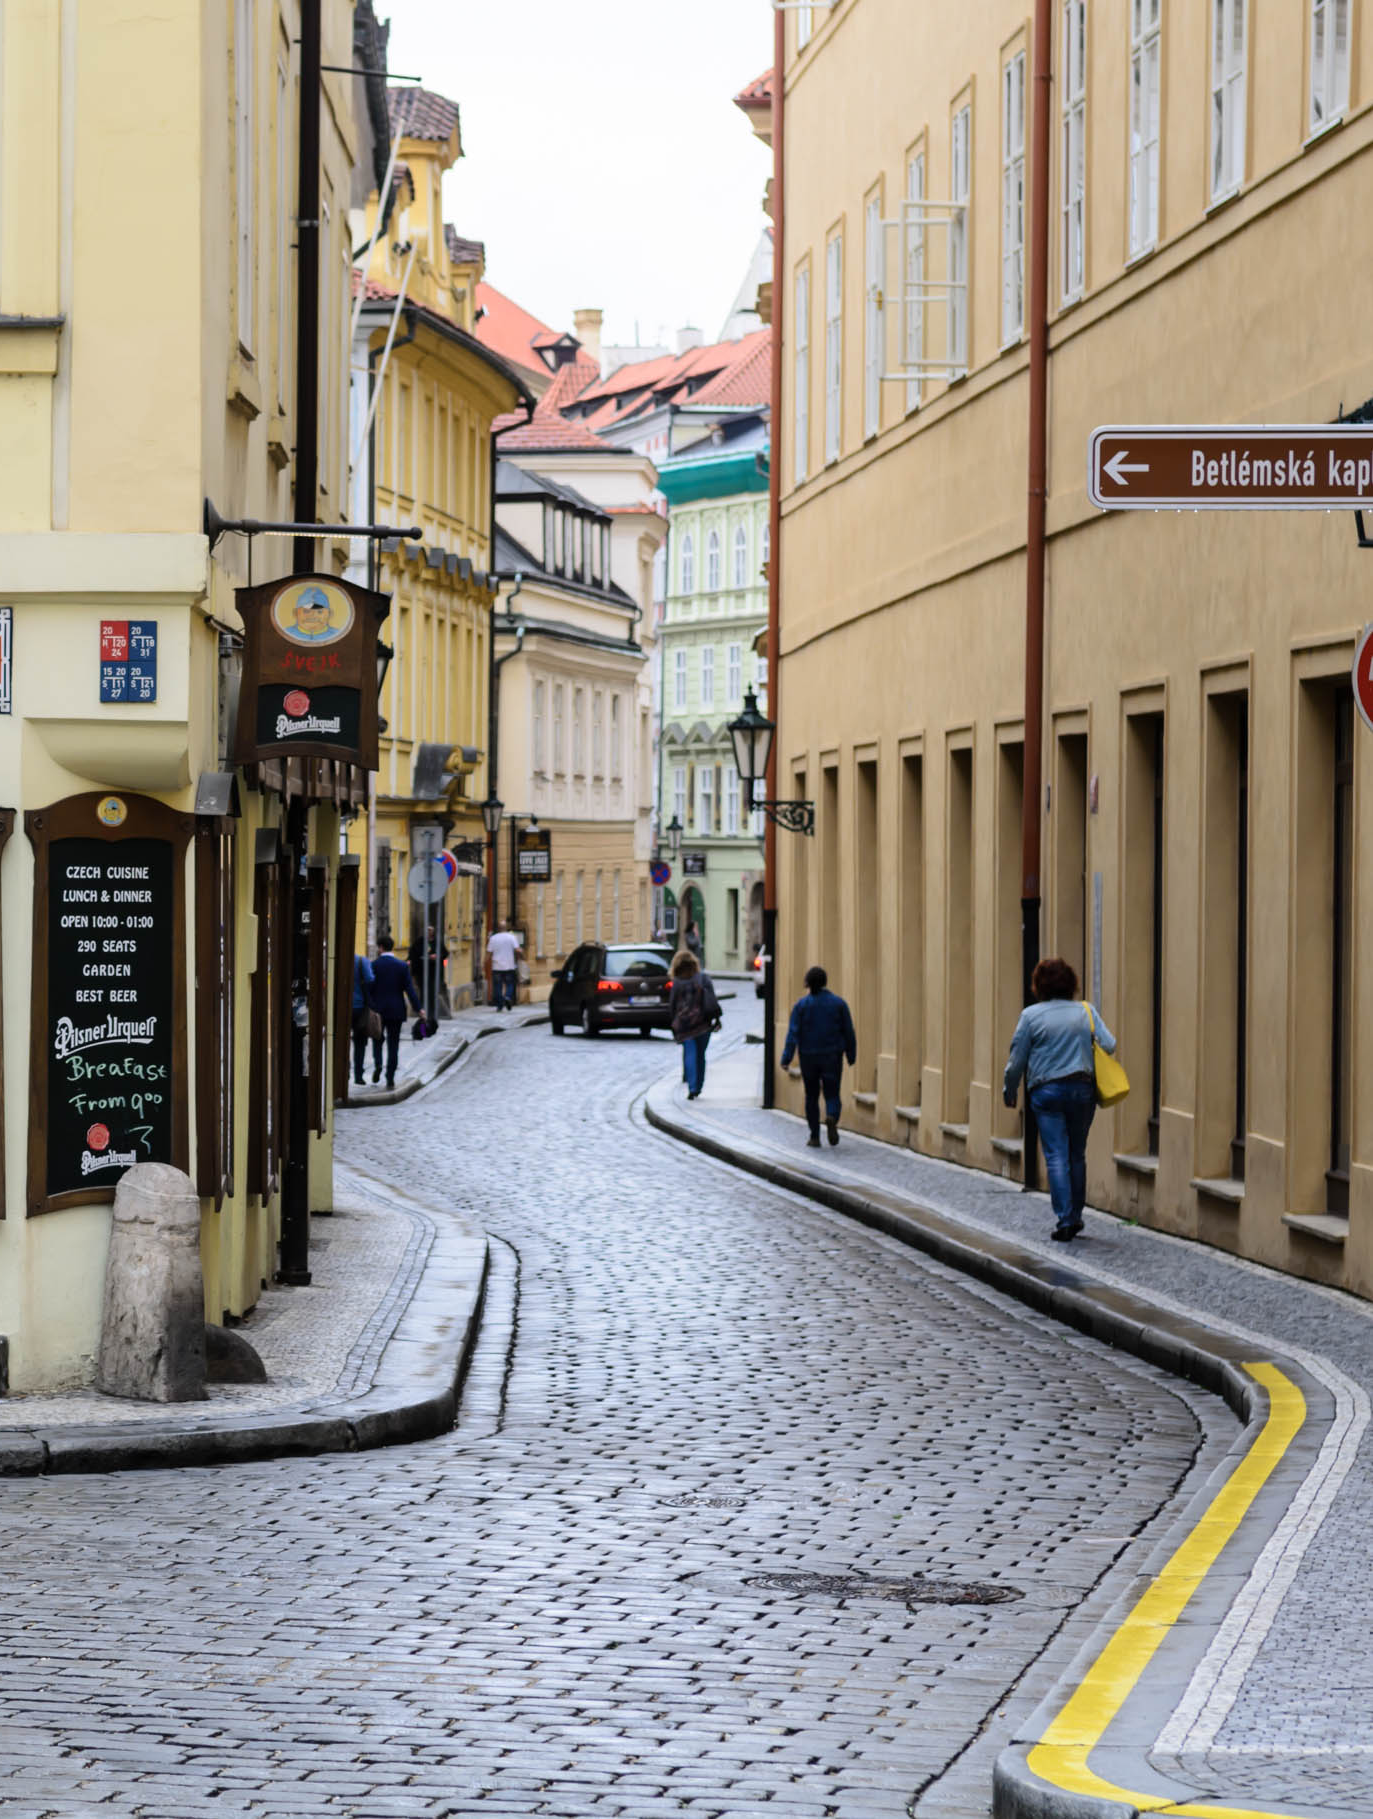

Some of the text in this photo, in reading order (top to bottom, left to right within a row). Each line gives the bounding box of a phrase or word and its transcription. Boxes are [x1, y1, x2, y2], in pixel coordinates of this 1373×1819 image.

[1192, 450, 1315, 486] Betlémská
[103, 626, 113, 635] 20
[131, 626, 142, 635] 20
[116, 639, 127, 647] 20
[111, 649, 122, 657] 24
[140, 649, 150, 657] 31
[103, 667, 127, 676] 15 20
[131, 667, 142, 676] 20
[145, 680, 154, 688] 21
[111, 689, 122, 698] 27
[140, 689, 151, 698] 20
[276, 714, 341, 739] Pilsner Urquell
[66, 866, 150, 880] CZECH CUISINE
[63, 890, 152, 903] LUNCH & DINNER
[60, 915, 89, 928] OPEN
[92, 915, 119, 928] 10:00
[126, 916, 154, 928] 01:00
[77, 940, 137, 953] 290 SEATS
[82, 964, 131, 977] GARDEN
[76, 990, 137, 1002] BEST BEER
[54, 1014, 158, 1060] Pilsner Urquell
[81, 1149, 137, 1176] Pilsner Urquell
